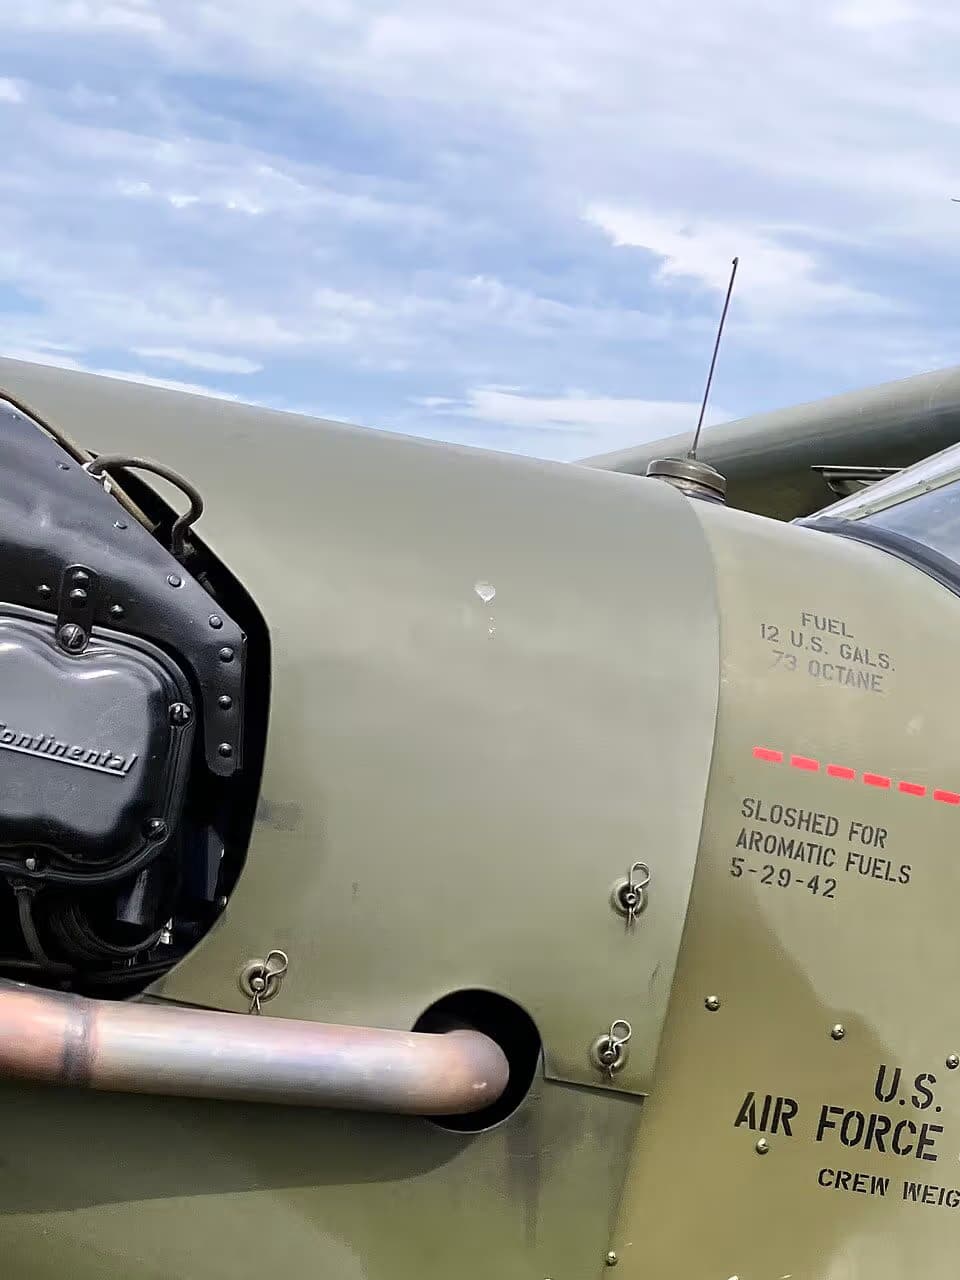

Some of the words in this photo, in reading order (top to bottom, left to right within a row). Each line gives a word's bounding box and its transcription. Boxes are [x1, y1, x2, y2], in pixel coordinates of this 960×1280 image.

[760, 624, 780, 643] 12
[790, 629, 829, 655] U.S.
[839, 643, 896, 672] GALS.
[801, 612, 854, 638] FUEL
[769, 650, 798, 671] 73
[808, 660, 884, 692] OCTANE
[741, 798, 840, 838] SLOSHED
[848, 821, 888, 849] FOR
[730, 857, 837, 899] 5-29-42
[735, 827, 838, 868] AROMATIC
[845, 852, 912, 885] FUELS
[874, 1064, 942, 1113] U.S.
[734, 1091, 799, 1137] AIR
[815, 1104, 944, 1162] FORCE
[817, 1168, 890, 1196] CREW
